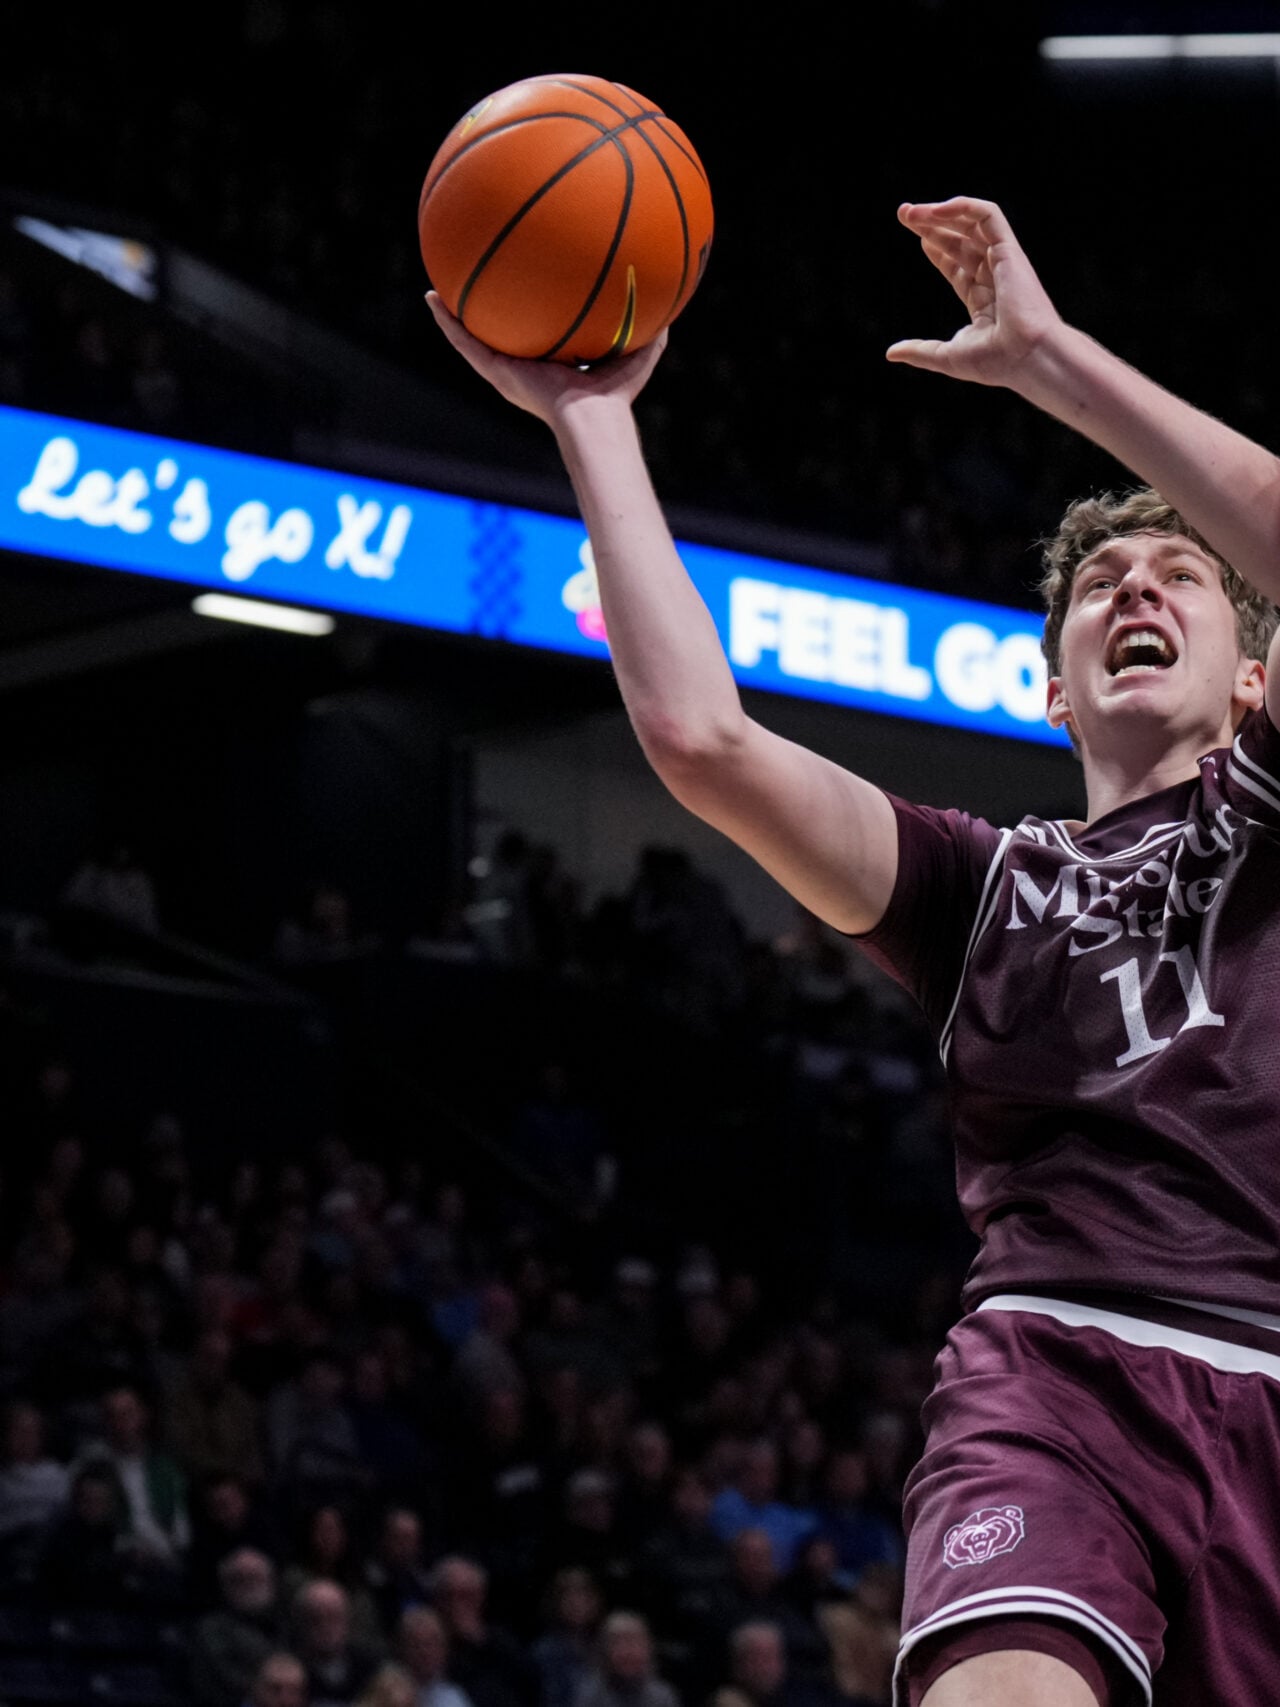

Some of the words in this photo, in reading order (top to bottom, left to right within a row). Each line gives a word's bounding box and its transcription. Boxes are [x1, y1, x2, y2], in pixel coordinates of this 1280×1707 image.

[17, 436, 211, 544] Let's
[221, 500, 313, 582] go
[325, 493, 412, 580] X!
[729, 577, 932, 700] FEEL
[1100, 945, 1225, 1068] 11
